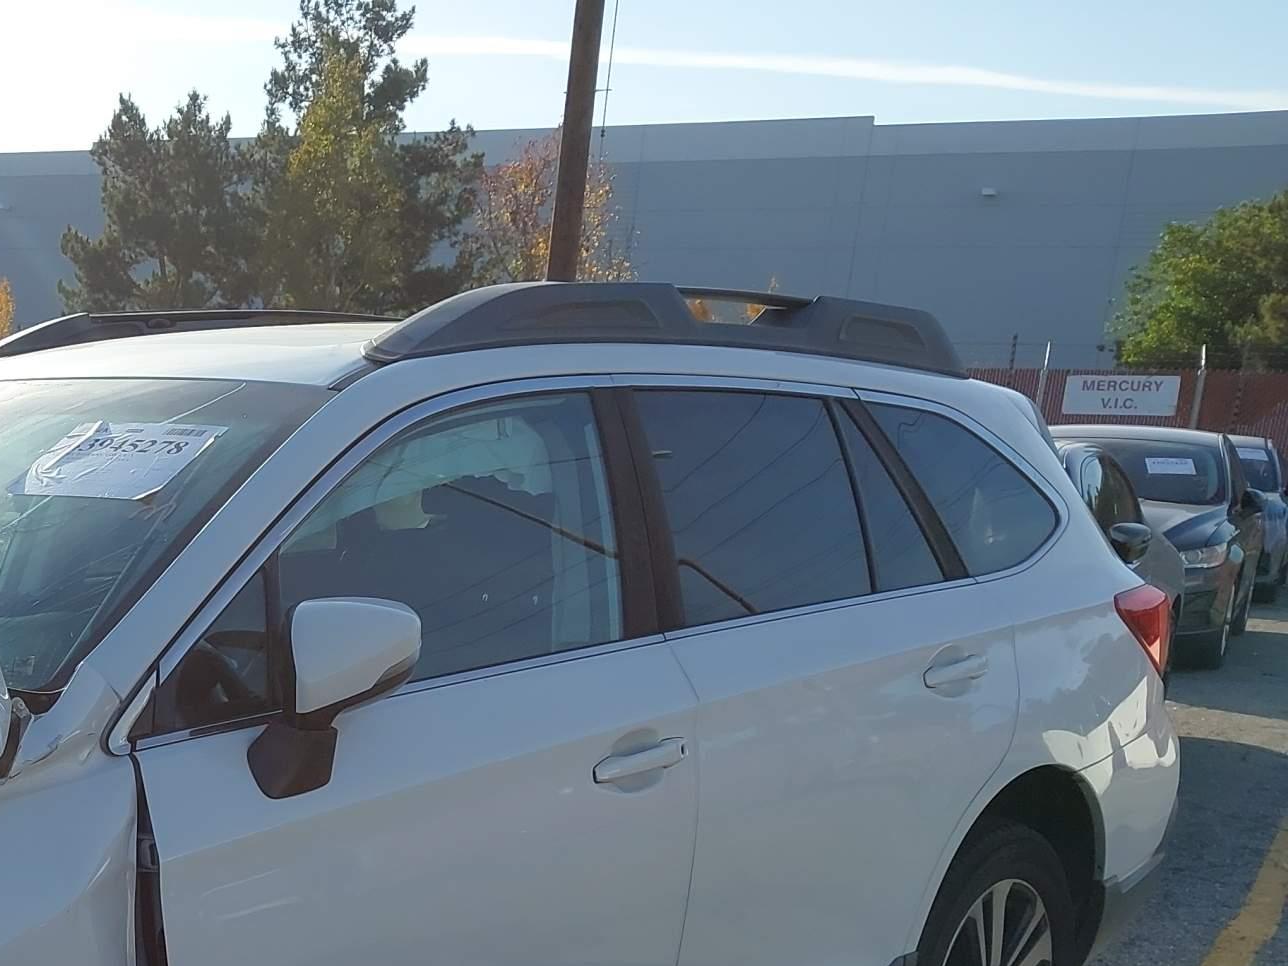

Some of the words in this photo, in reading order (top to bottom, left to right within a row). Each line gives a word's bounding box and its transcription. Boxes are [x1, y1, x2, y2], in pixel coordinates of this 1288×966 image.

[1081, 379, 1164, 392] MERCURY
[1101, 397, 1138, 410] V.I.C.
[75, 437, 189, 455] 3945278
